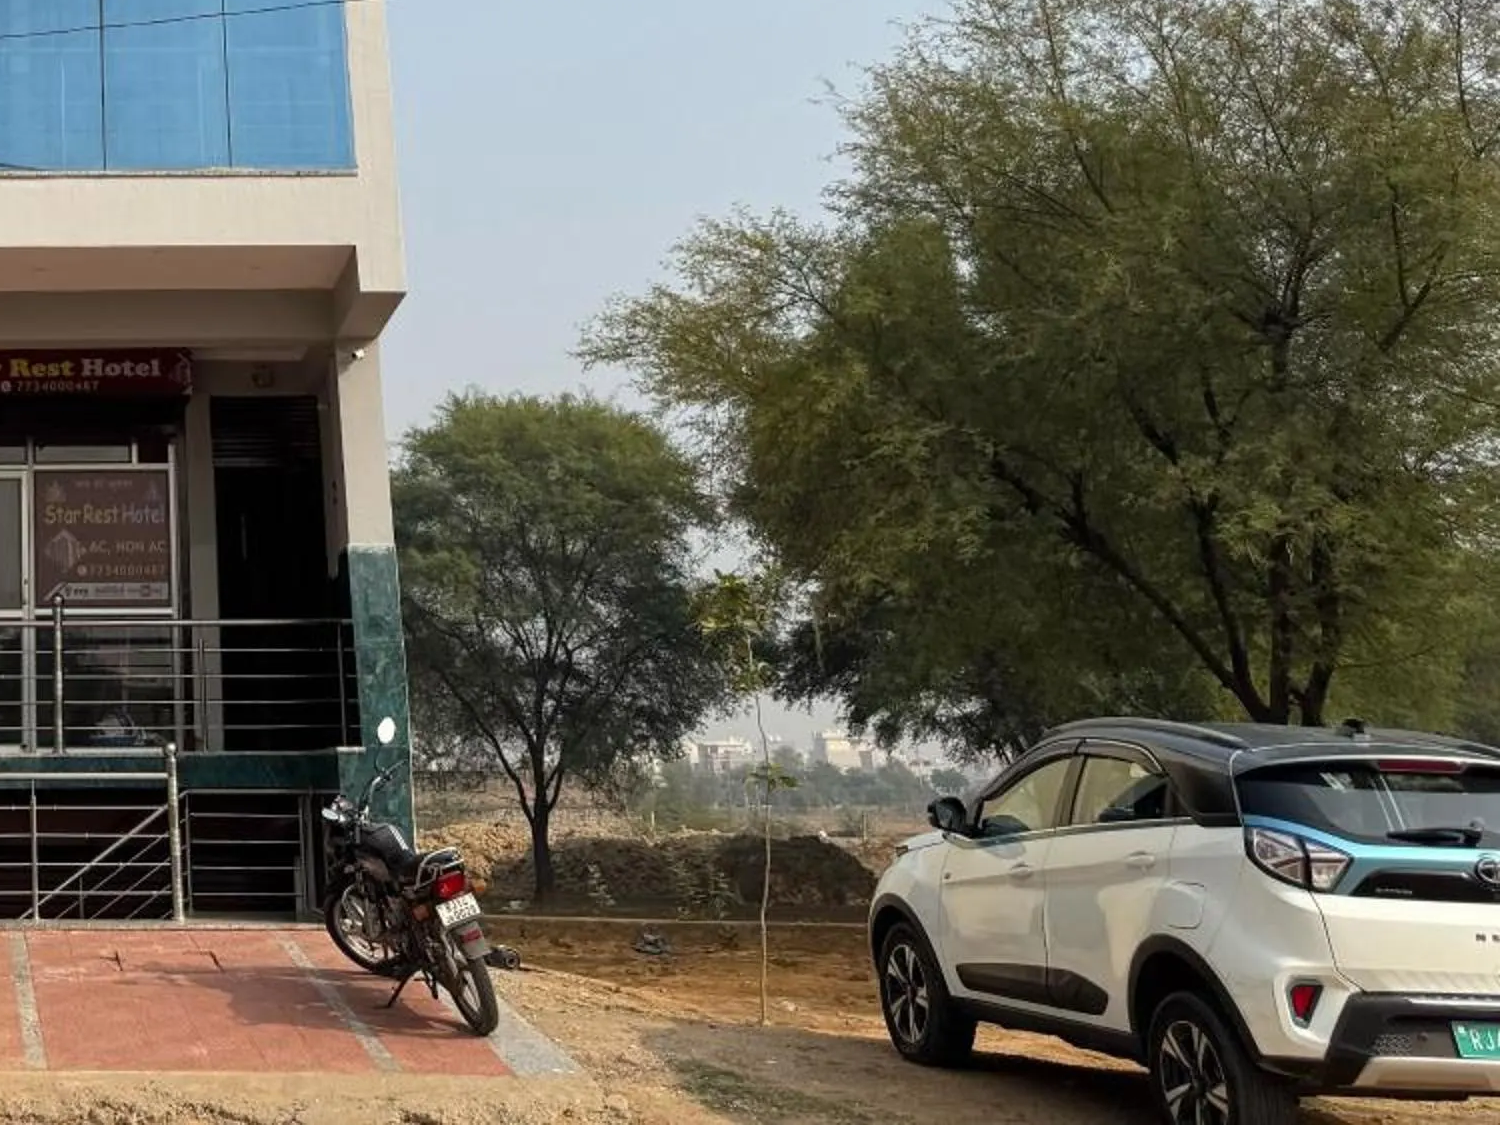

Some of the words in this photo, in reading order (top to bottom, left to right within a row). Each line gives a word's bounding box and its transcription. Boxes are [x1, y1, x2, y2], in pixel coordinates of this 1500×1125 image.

[9, 358, 75, 377] Rest
[80, 357, 161, 377] Hotel
[44, 503, 82, 525] Star
[83, 503, 119, 525] Rest
[121, 502, 165, 525] Hotel
[115, 539, 145, 553] NON
[148, 539, 166, 553] AC
[1468, 1027, 1500, 1052] RJ
